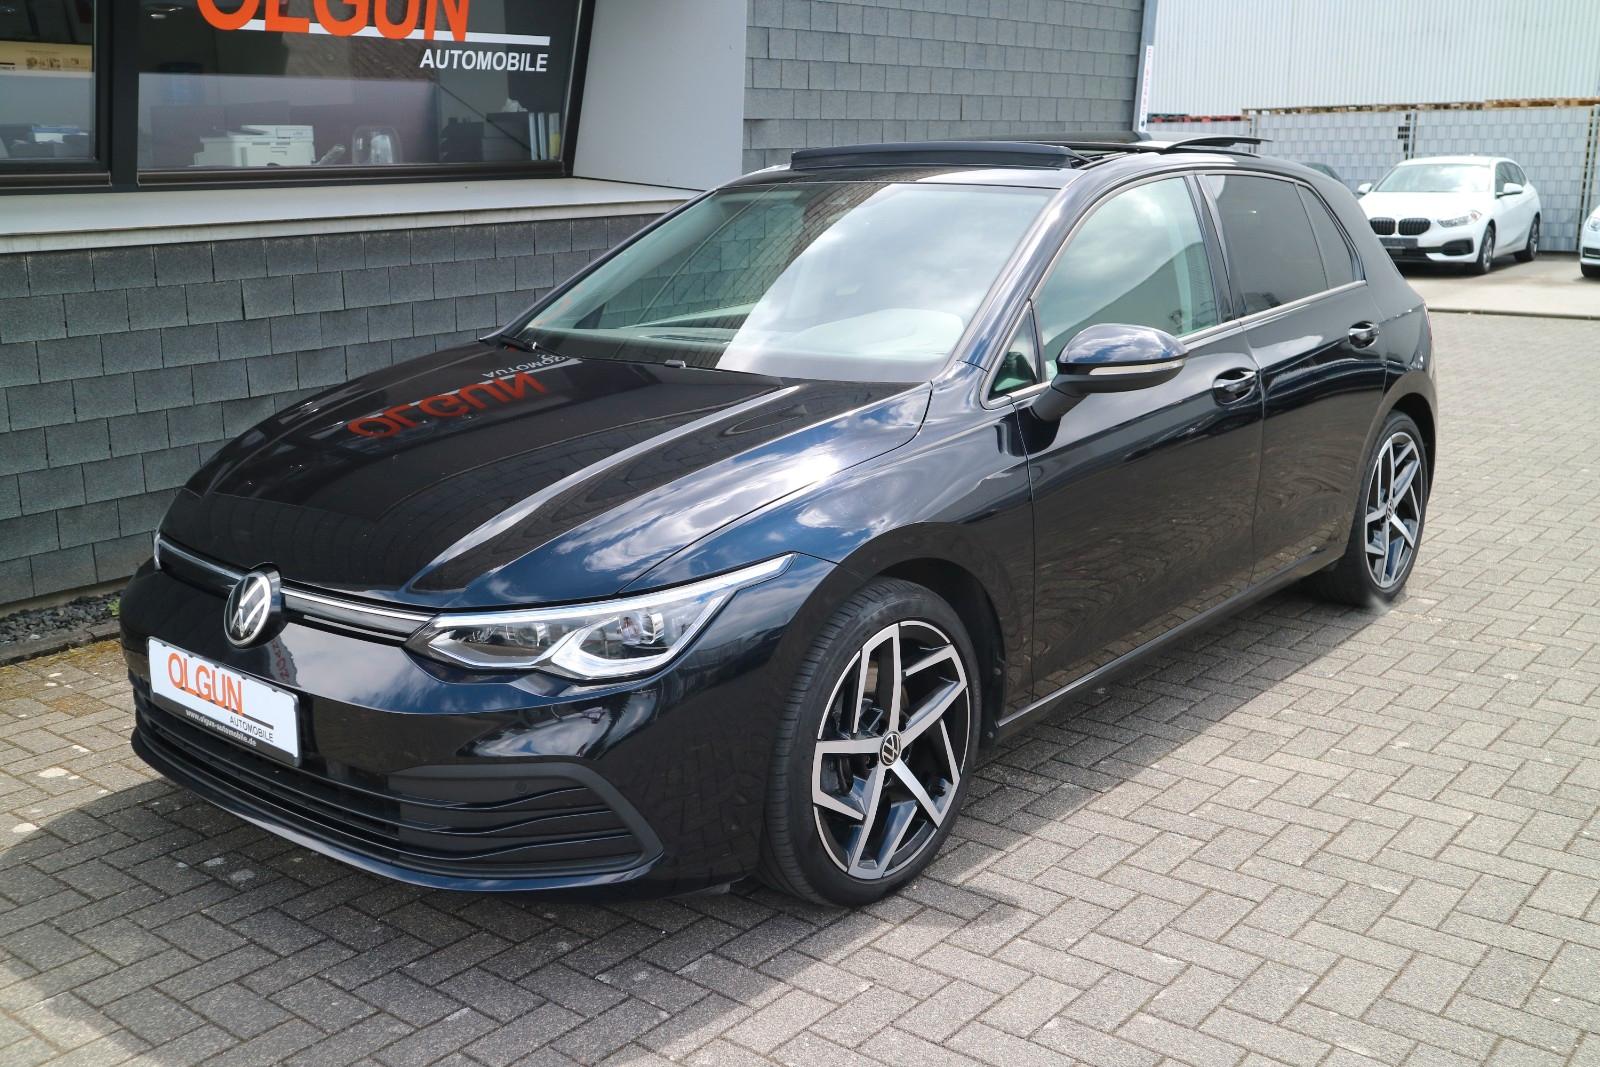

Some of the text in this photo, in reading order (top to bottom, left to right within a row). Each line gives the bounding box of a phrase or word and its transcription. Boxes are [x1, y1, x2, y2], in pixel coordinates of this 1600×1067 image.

[419, 48, 549, 72] AUTOMOBILE
[168, 652, 244, 716] OLGUN
[185, 710, 257, 747] www.olgun-automobile.de
[229, 715, 274, 742] AUTOMOBILE
